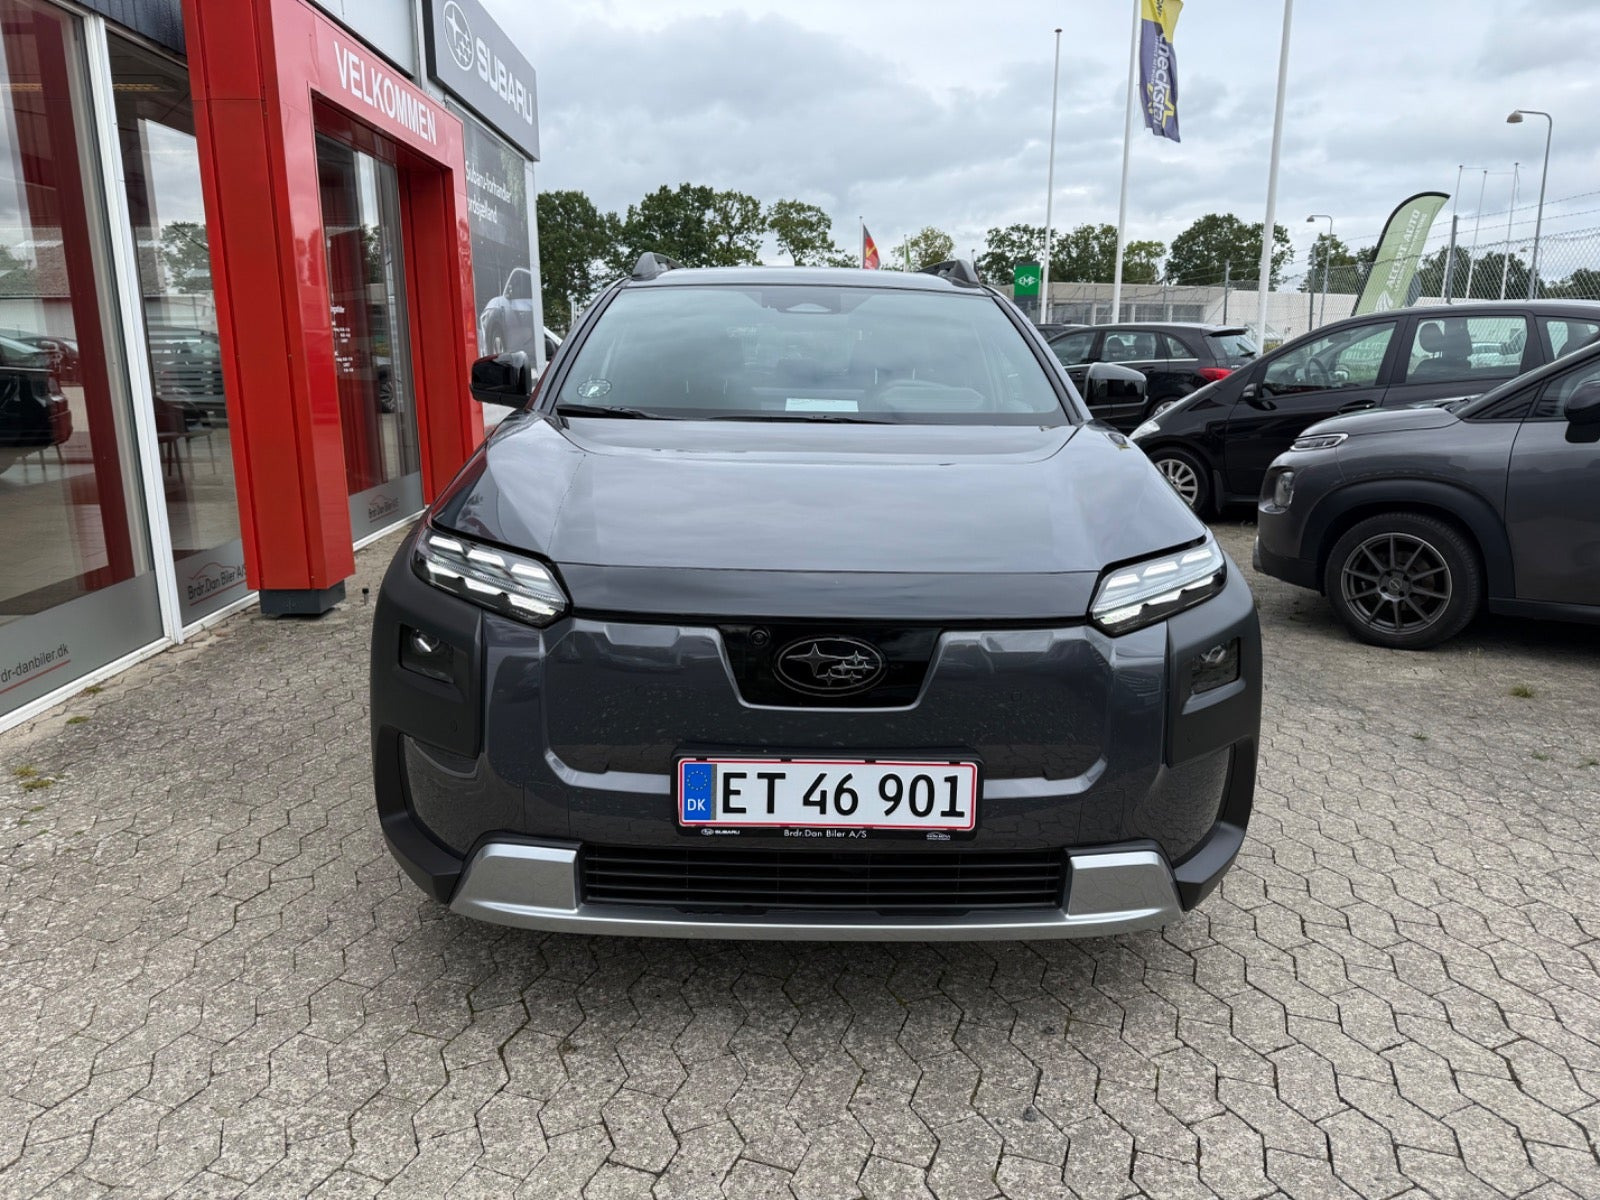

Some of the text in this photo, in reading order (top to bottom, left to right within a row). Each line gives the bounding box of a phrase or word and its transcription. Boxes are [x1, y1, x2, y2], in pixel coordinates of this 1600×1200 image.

[333, 40, 437, 146] VELKOMMEN
[476, 37, 534, 126] SUBARU
[687, 798, 706, 811] DK
[722, 772, 965, 818] ET 46 901
[784, 829, 867, 839] Brdr.Dan Biler A/S
